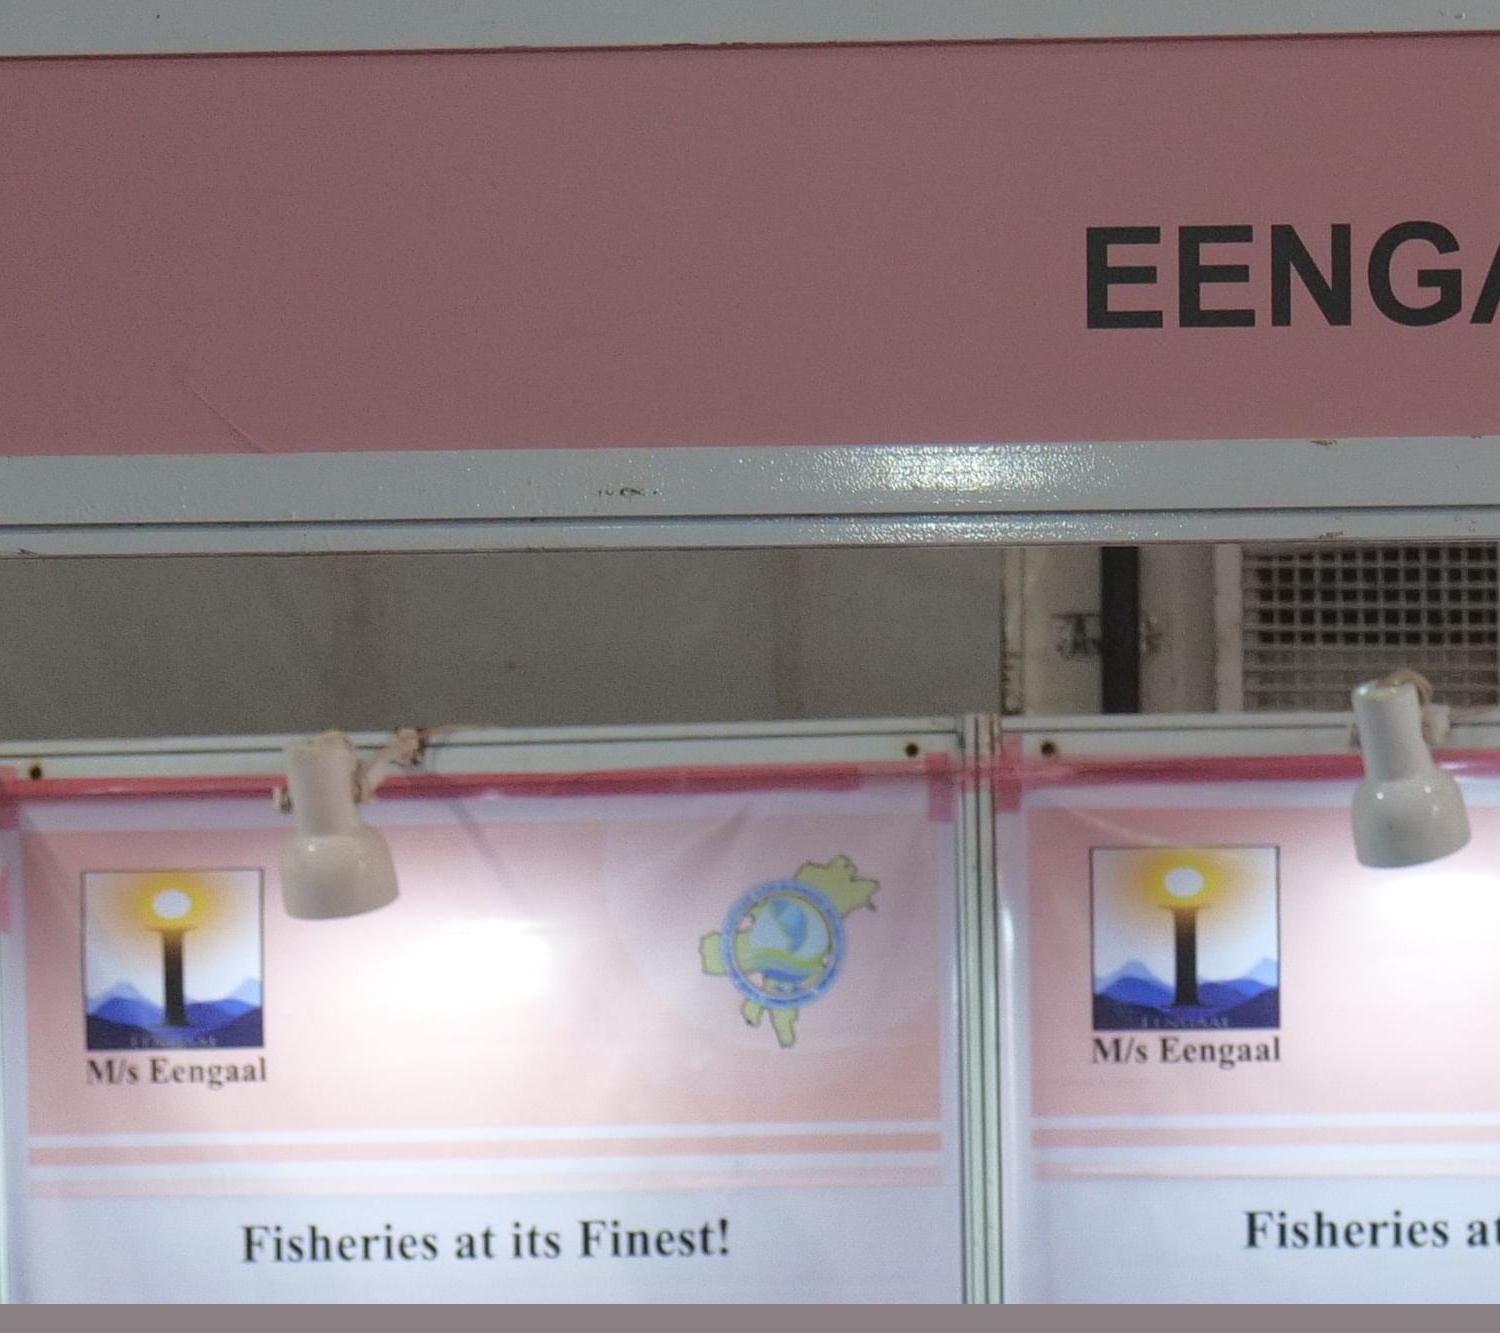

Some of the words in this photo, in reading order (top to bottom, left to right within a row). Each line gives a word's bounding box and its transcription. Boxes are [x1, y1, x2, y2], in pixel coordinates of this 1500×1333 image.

[1093, 1037, 1149, 1064] M/s
[1159, 1035, 1281, 1069] Eengaal
[87, 1058, 139, 1085] M/s
[150, 1055, 267, 1090] Eengaal
[241, 1223, 438, 1264] Fisheries
[454, 1226, 495, 1260] at
[512, 1221, 561, 1260] its
[579, 1219, 731, 1258] Finest!
[1244, 1208, 1449, 1249] Fisheries
